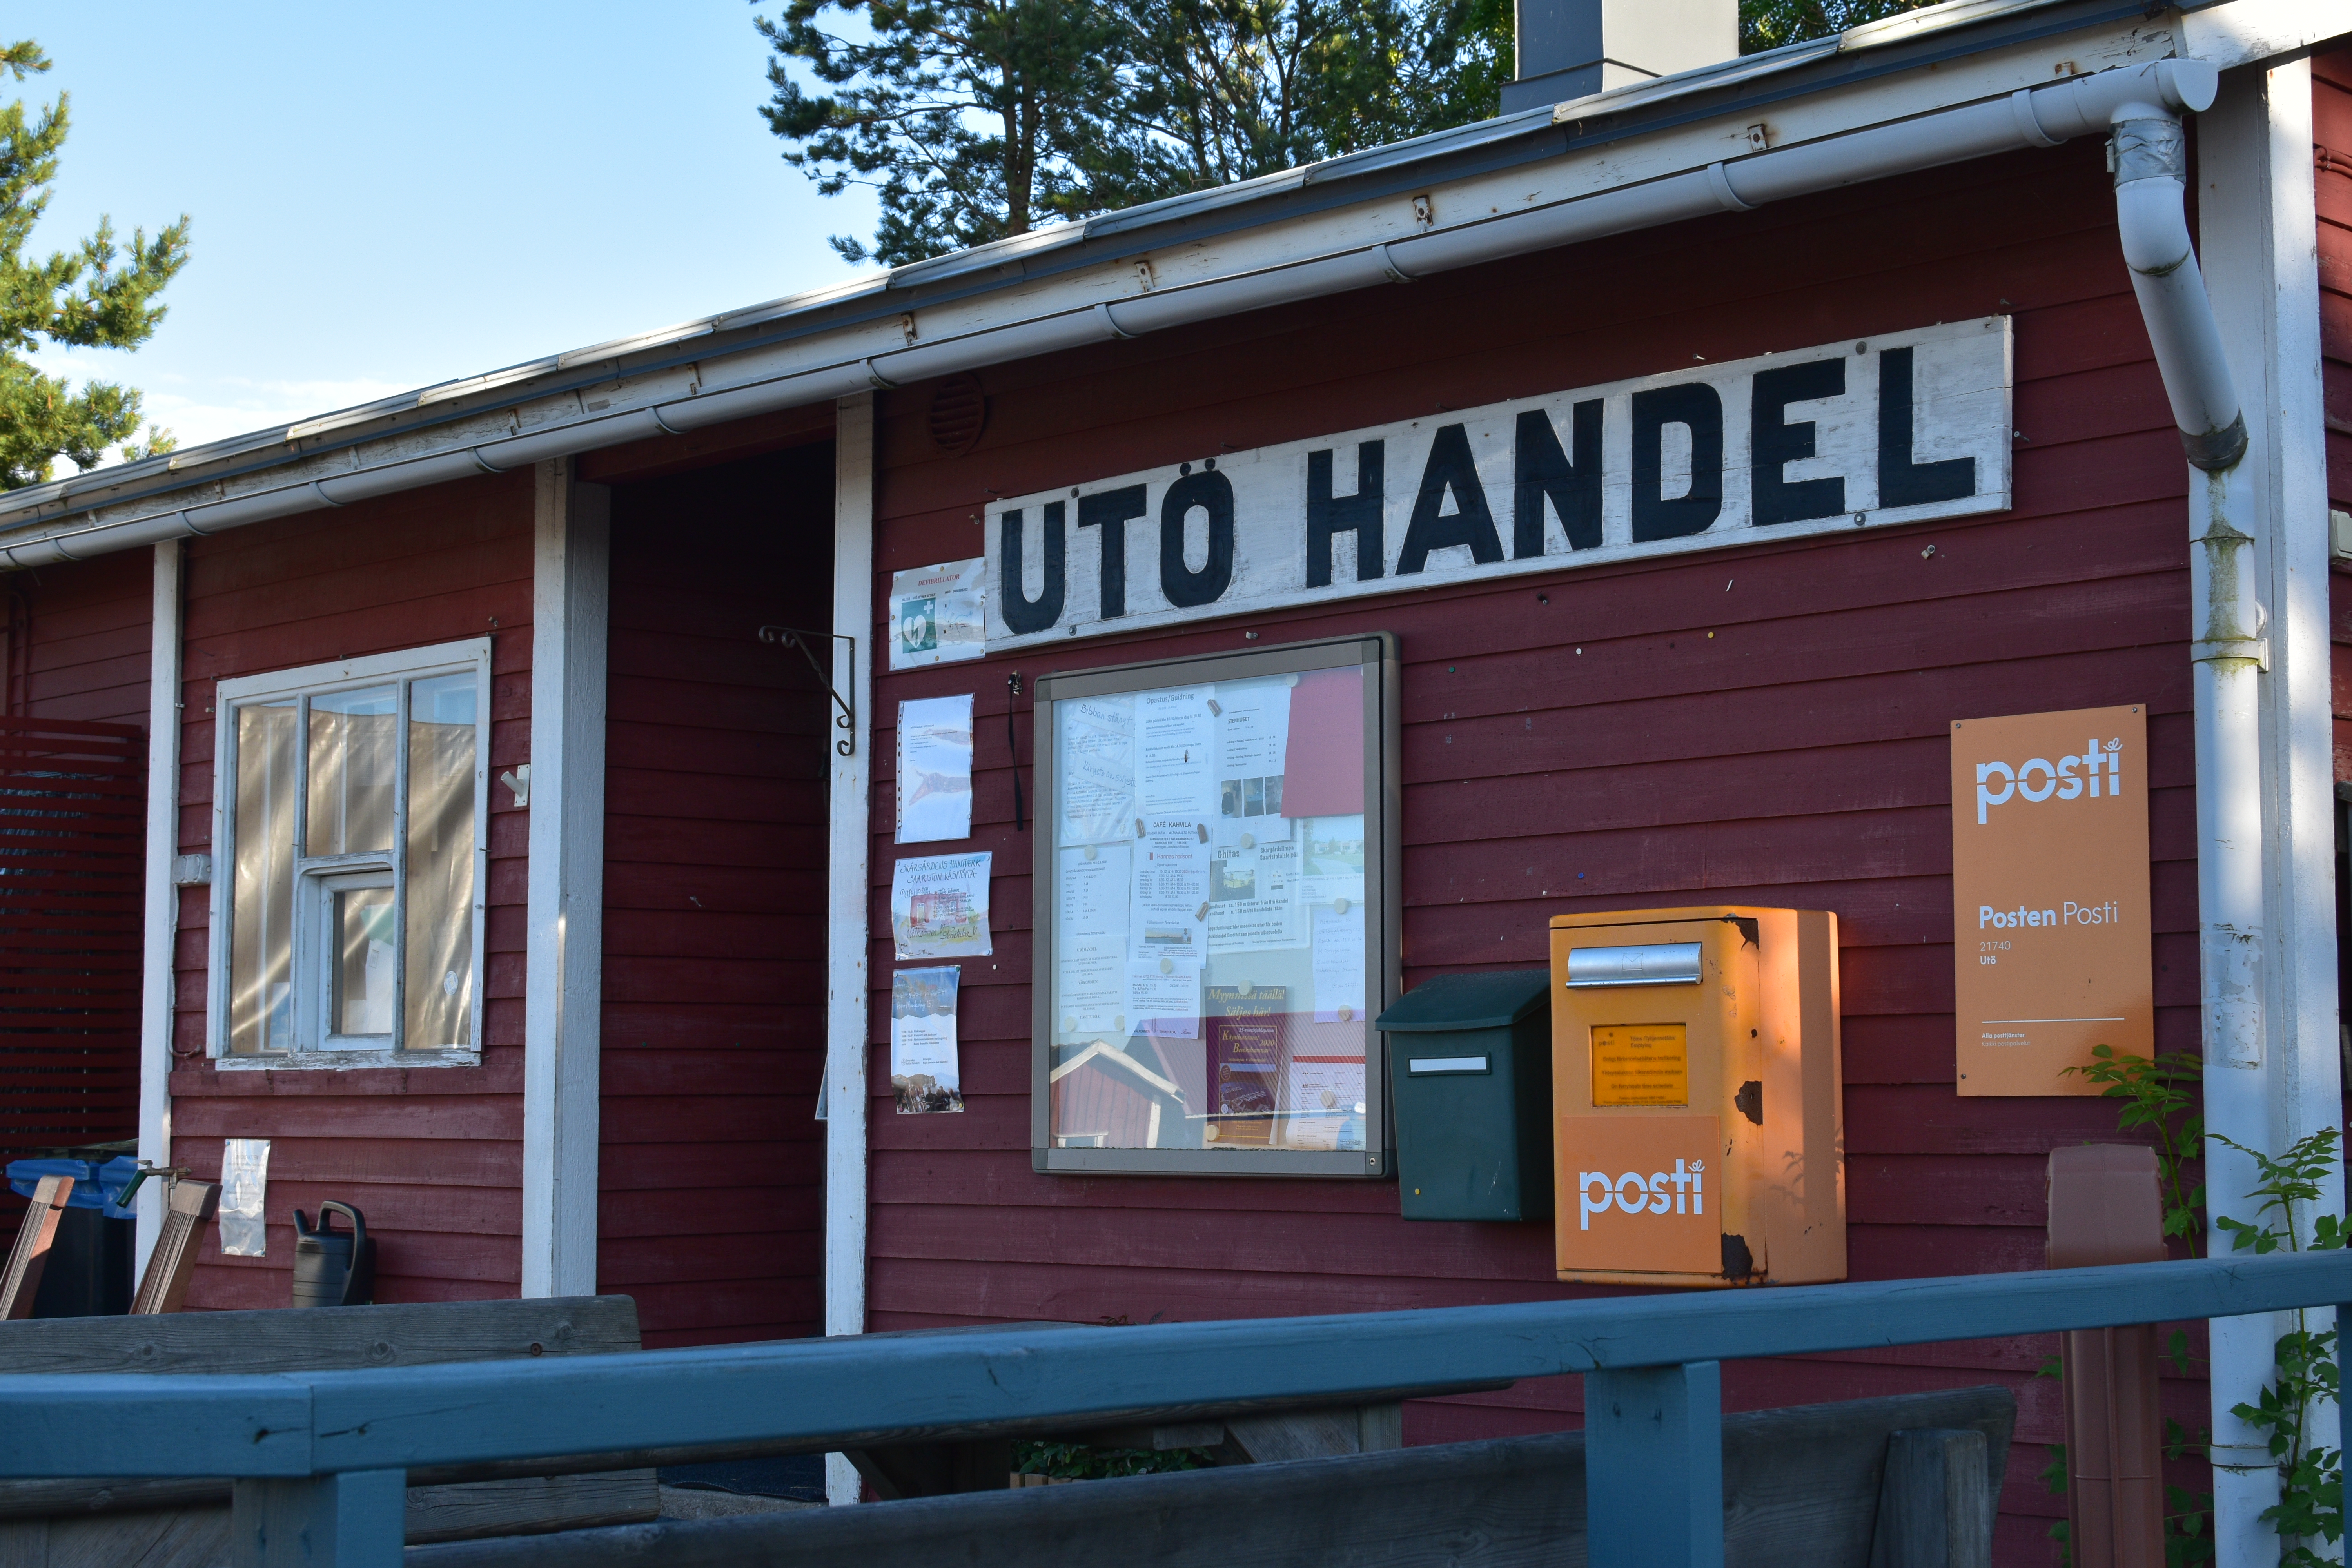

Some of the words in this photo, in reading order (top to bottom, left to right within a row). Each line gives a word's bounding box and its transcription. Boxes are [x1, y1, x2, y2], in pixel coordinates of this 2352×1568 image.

[1001, 458, 1234, 634] UTÖ
[1307, 346, 1976, 588] HANDEL
[918, 574, 960, 586] DEFIBRILLATOR
[1146, 693, 1194, 705] Opastus/Guidning
[1080, 704, 1105, 720] Bibban
[1107, 712, 1133, 729] stängt
[1976, 737, 2123, 824] posti
[1218, 850, 1240, 858] Ghitas
[900, 861, 948, 873] SKÄRGÅRDENS
[950, 859, 980, 868] HANTVERK
[907, 873, 942, 884] SAARISTON
[900, 889, 922, 898] POP-UP
[1979, 906, 2056, 929] Posten
[2063, 901, 2117, 925] Posti
[907, 926, 937, 938] Välkommen
[1980, 941, 2011, 951] 21740
[1980, 956, 1996, 965] Utö
[1207, 989, 1257, 1003] Myynnissä
[1259, 989, 1285, 1000] täällä!
[906, 1000, 925, 1011] Musikdag
[1225, 1005, 1251, 1020] Säljes
[1253, 1006, 1271, 1017] här!
[1579, 1158, 1705, 1230] posti
